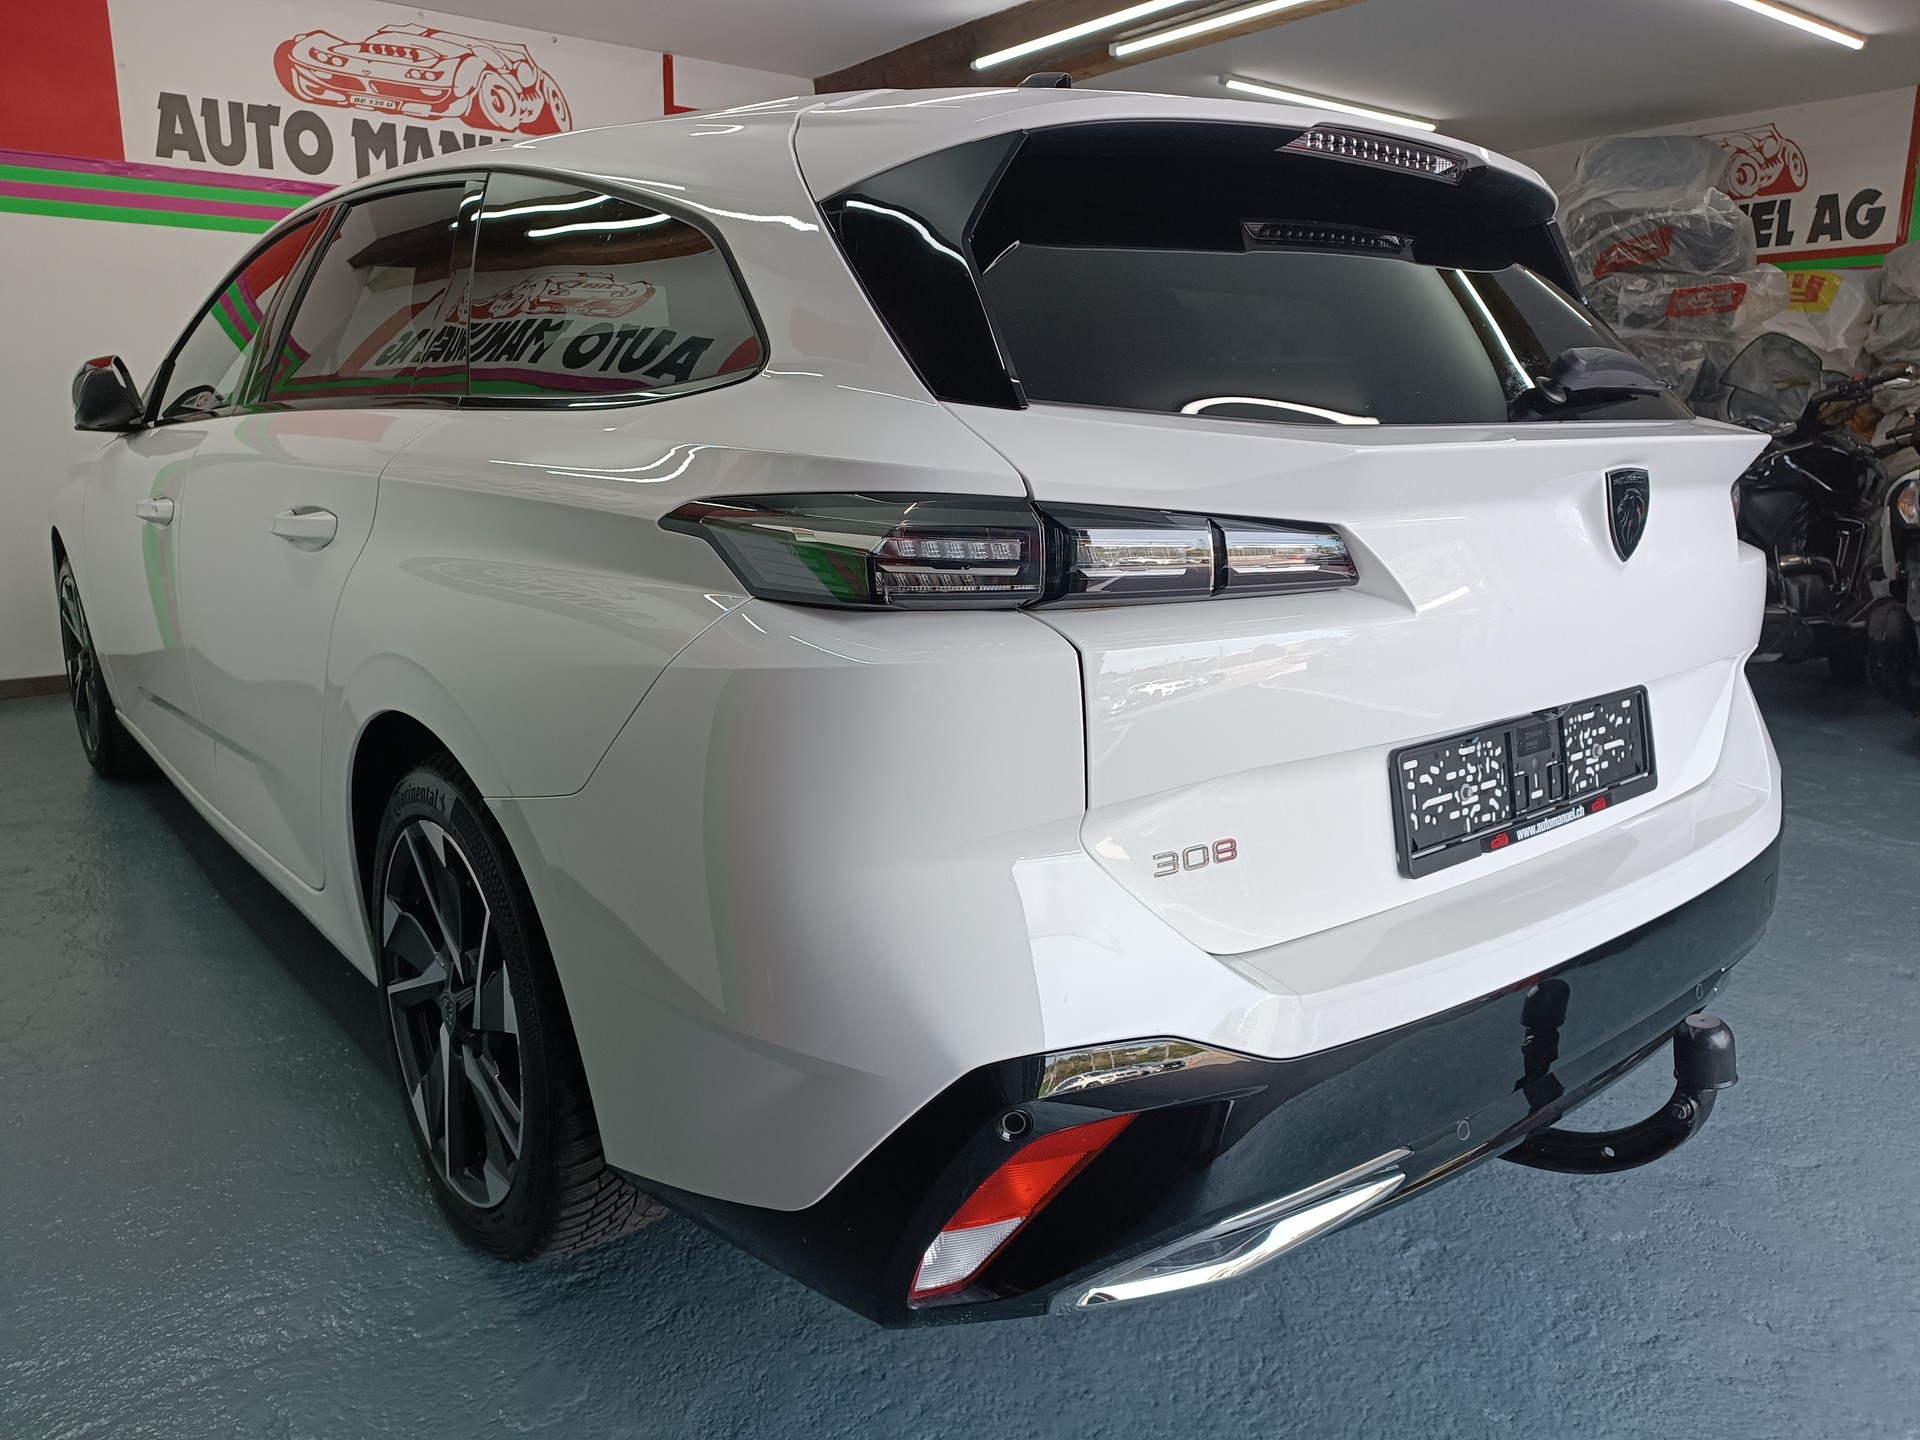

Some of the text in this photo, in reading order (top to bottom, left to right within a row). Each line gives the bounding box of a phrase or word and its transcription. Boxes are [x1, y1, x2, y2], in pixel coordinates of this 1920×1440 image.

[155, 91, 334, 175] AUTO
[1806, 188, 1886, 244] AG
[1613, 475, 1647, 486] PEUGEOT
[1516, 805, 1585, 840] www.automanuel.ch
[1152, 838, 1238, 878] 308
